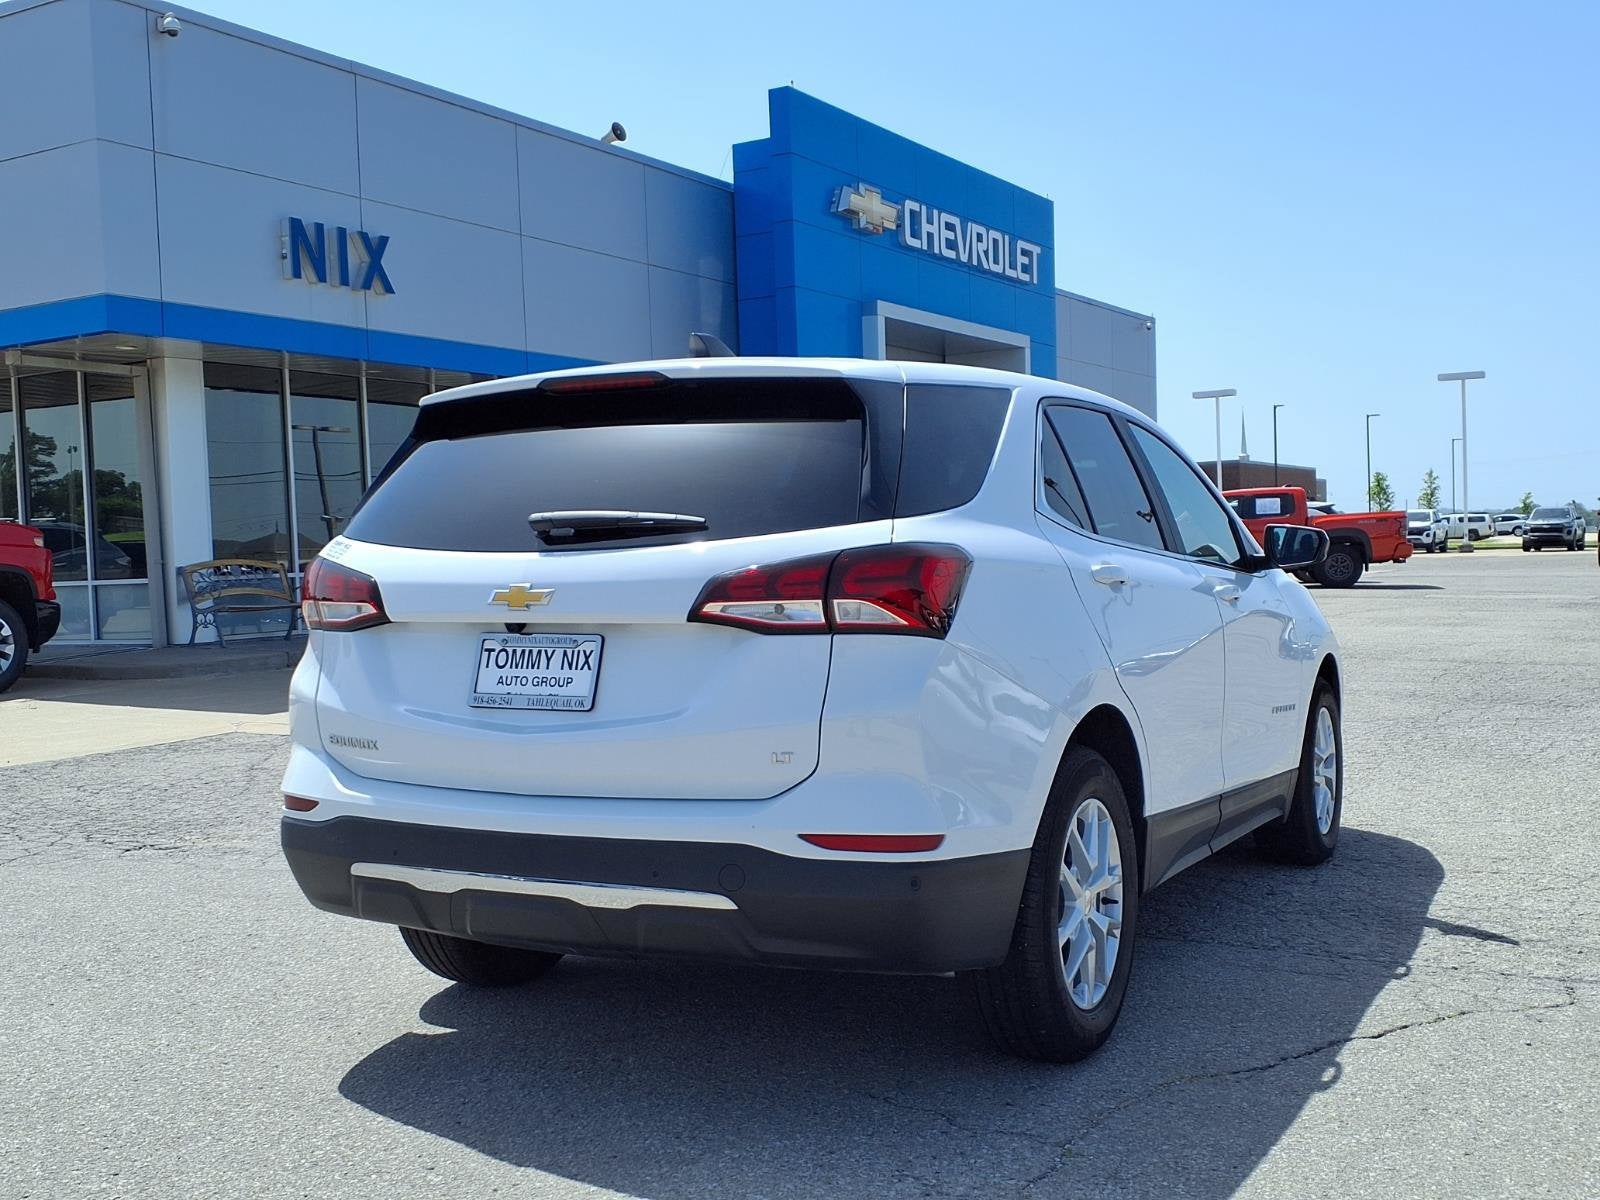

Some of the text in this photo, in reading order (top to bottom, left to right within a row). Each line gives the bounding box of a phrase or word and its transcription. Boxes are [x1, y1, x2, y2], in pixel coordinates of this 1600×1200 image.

[904, 199, 1041, 284] CHEVROLET
[287, 216, 396, 294] NIX
[484, 648, 594, 671] TOMMY NIX
[496, 675, 574, 688] AUTO GROUP
[771, 751, 794, 765] LT
